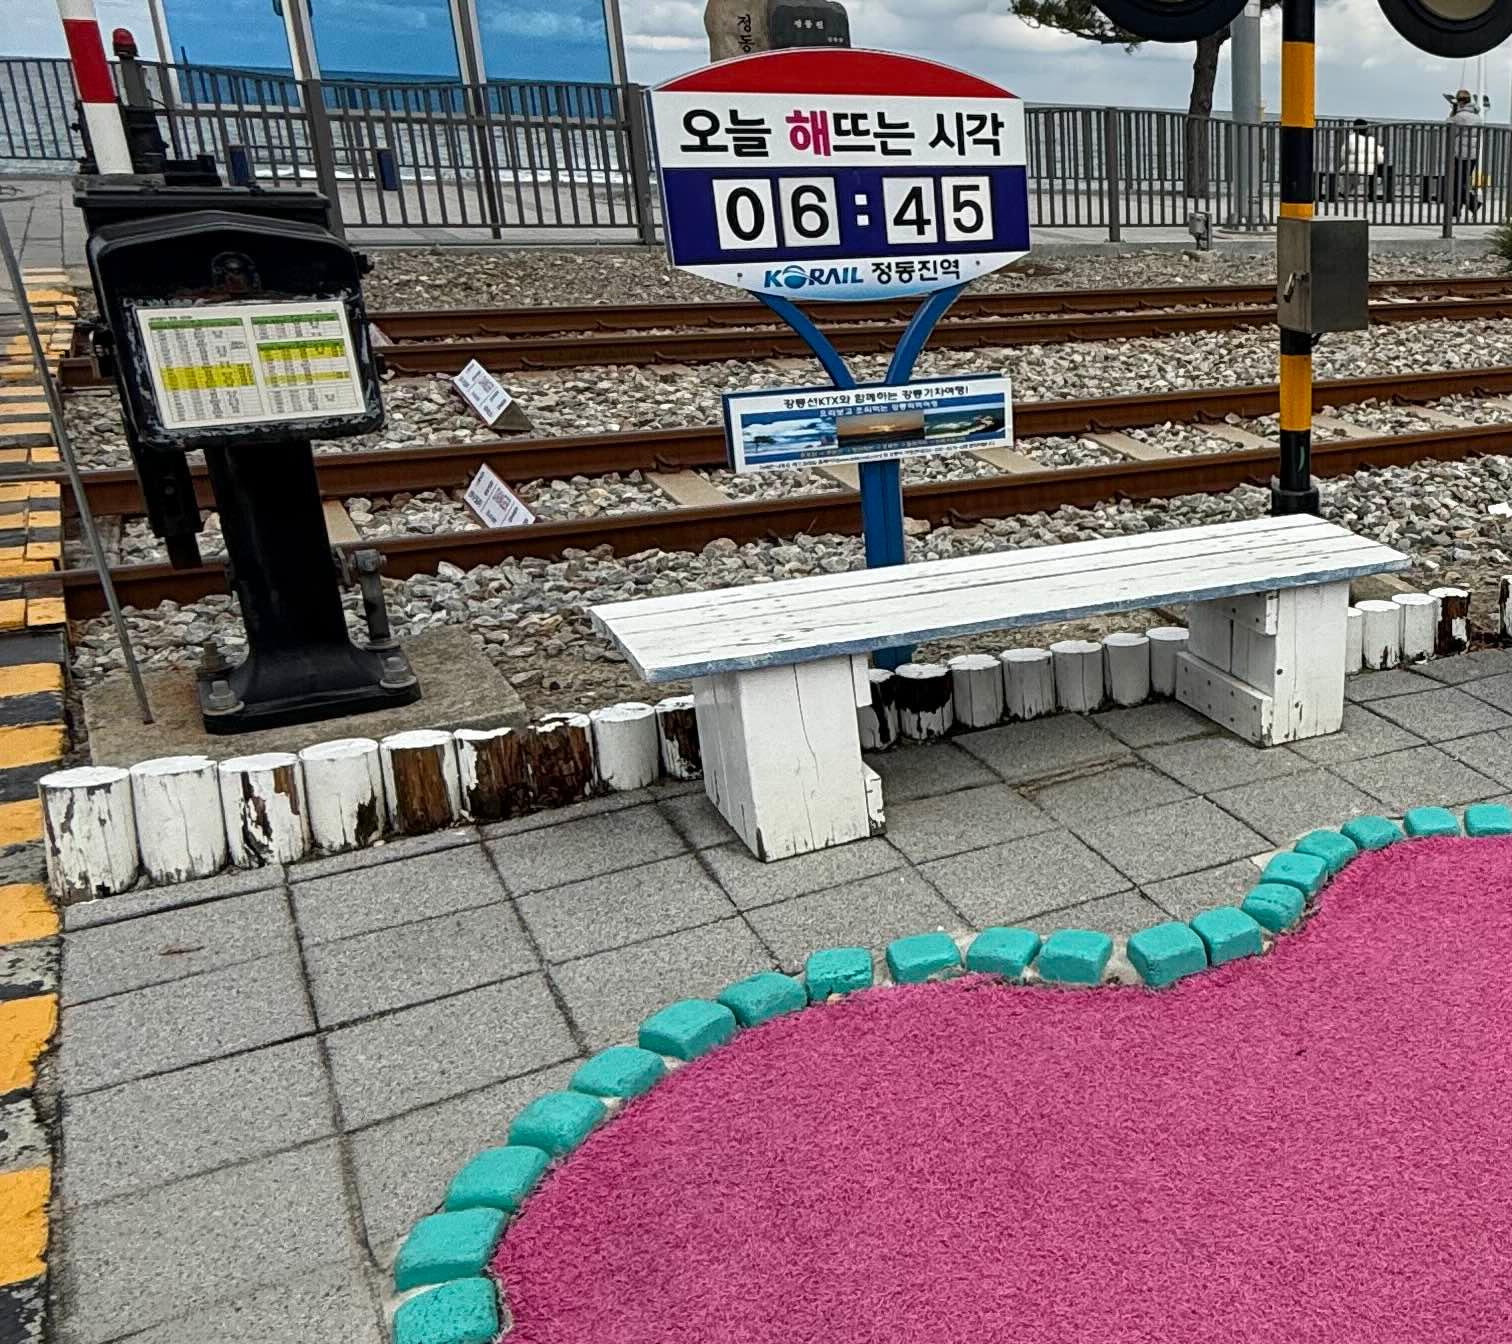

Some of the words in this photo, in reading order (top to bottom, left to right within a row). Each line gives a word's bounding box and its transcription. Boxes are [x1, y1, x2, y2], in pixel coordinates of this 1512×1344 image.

[680, 109, 772, 157] 오늘
[785, 110, 915, 157] 해뜨는
[929, 111, 1005, 156] 시각
[725, 184, 985, 242] 06:45
[764, 264, 864, 289] KORAIL
[871, 259, 960, 284] 정동진역
